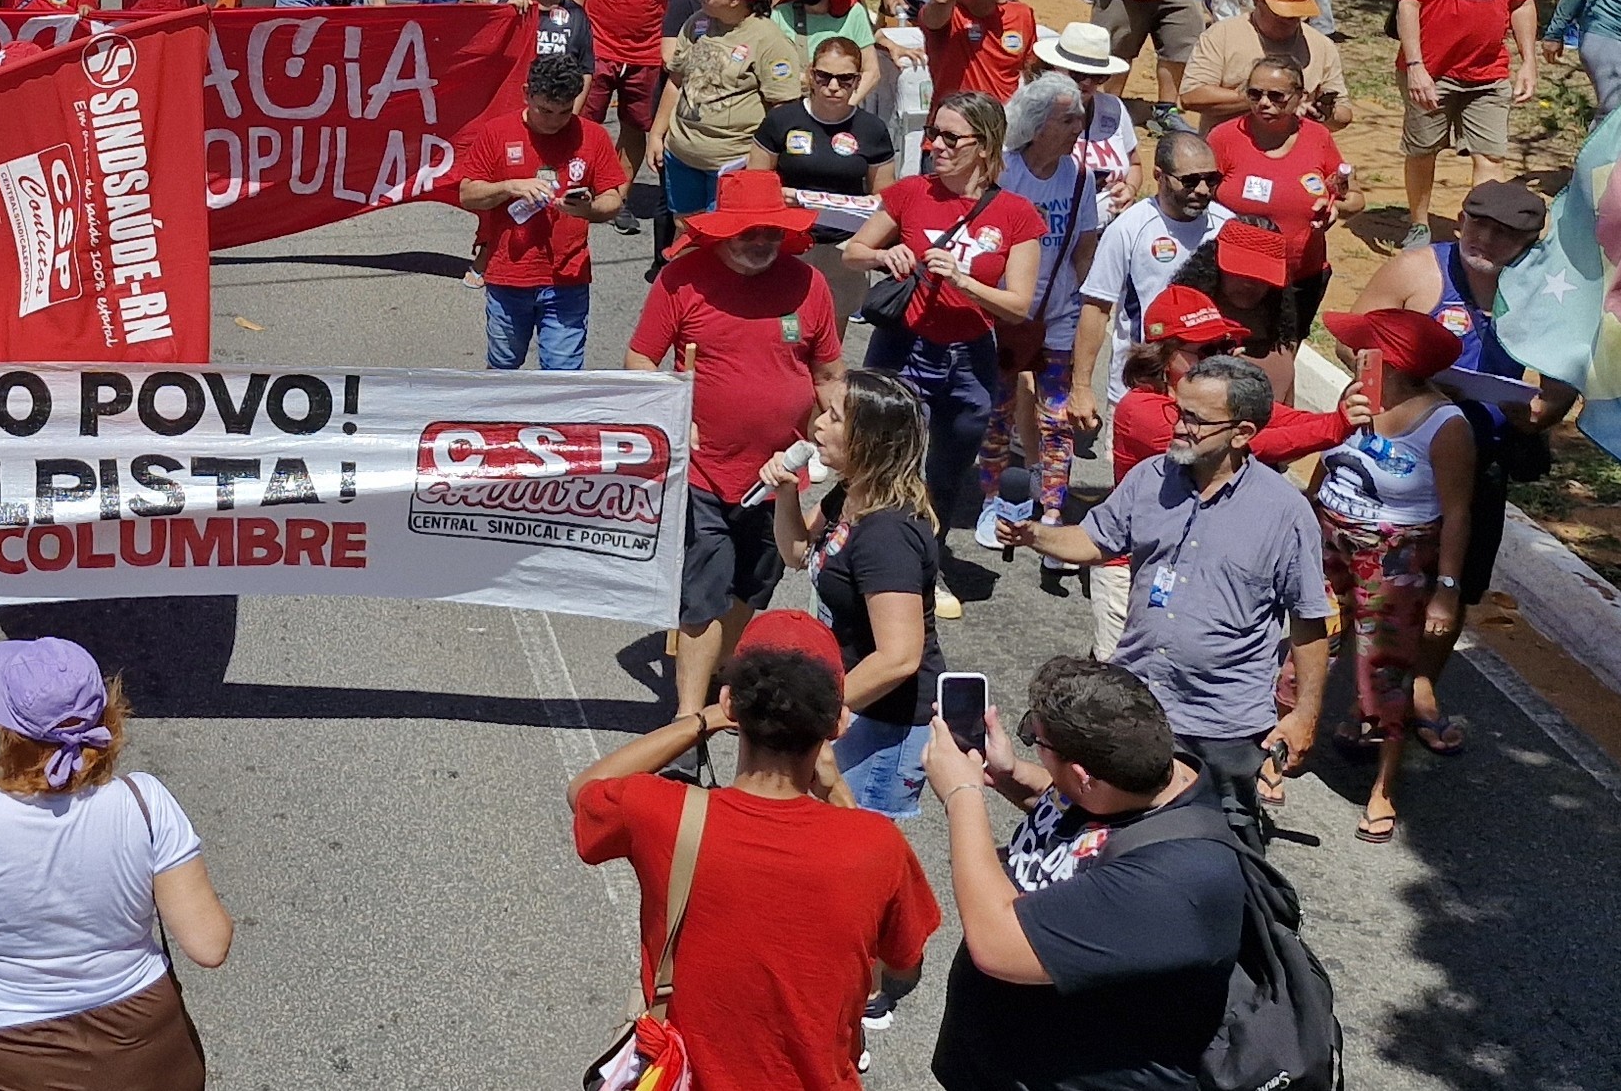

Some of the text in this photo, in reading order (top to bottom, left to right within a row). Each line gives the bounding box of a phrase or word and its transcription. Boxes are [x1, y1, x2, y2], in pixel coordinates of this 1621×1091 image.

[551, 32, 567, 45] DA
[16, 174, 45, 296] Conlutas
[50, 159, 75, 290] CSP
[85, 202, 104, 244] saúde
[90, 87, 173, 344] SINDSAÚDE-RN
[90, 250, 104, 292] 100%
[96, 295, 114, 348] estatal
[79, 373, 360, 437] POVO!
[433, 426, 654, 477] CSP
[413, 515, 651, 551] CENTRAL SINDICAL E POPULAR
